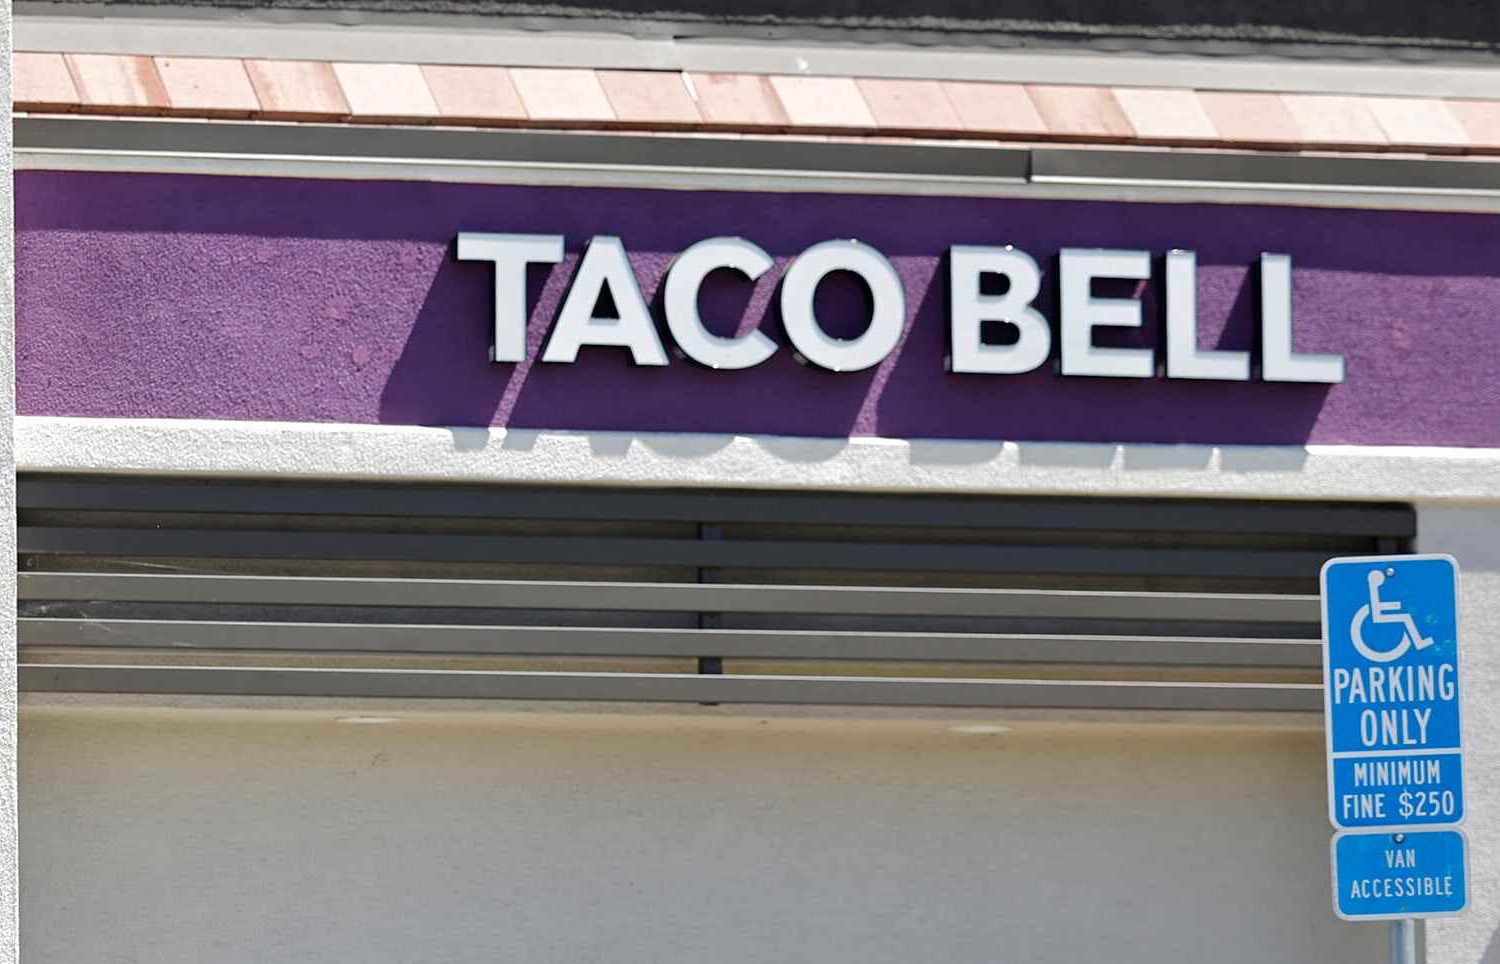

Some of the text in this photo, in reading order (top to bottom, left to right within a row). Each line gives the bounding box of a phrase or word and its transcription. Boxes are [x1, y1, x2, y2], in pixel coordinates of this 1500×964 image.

[456, 231, 1346, 383] TACO BELL
[1333, 662, 1455, 705] PARKING
[1360, 708, 1432, 747] ONLY
[1353, 759, 1441, 787] MINIMUM
[1342, 789, 1455, 820] FINE $250
[1385, 848, 1416, 869] VAN
[1350, 876, 1453, 899] ACCESSIBLE
